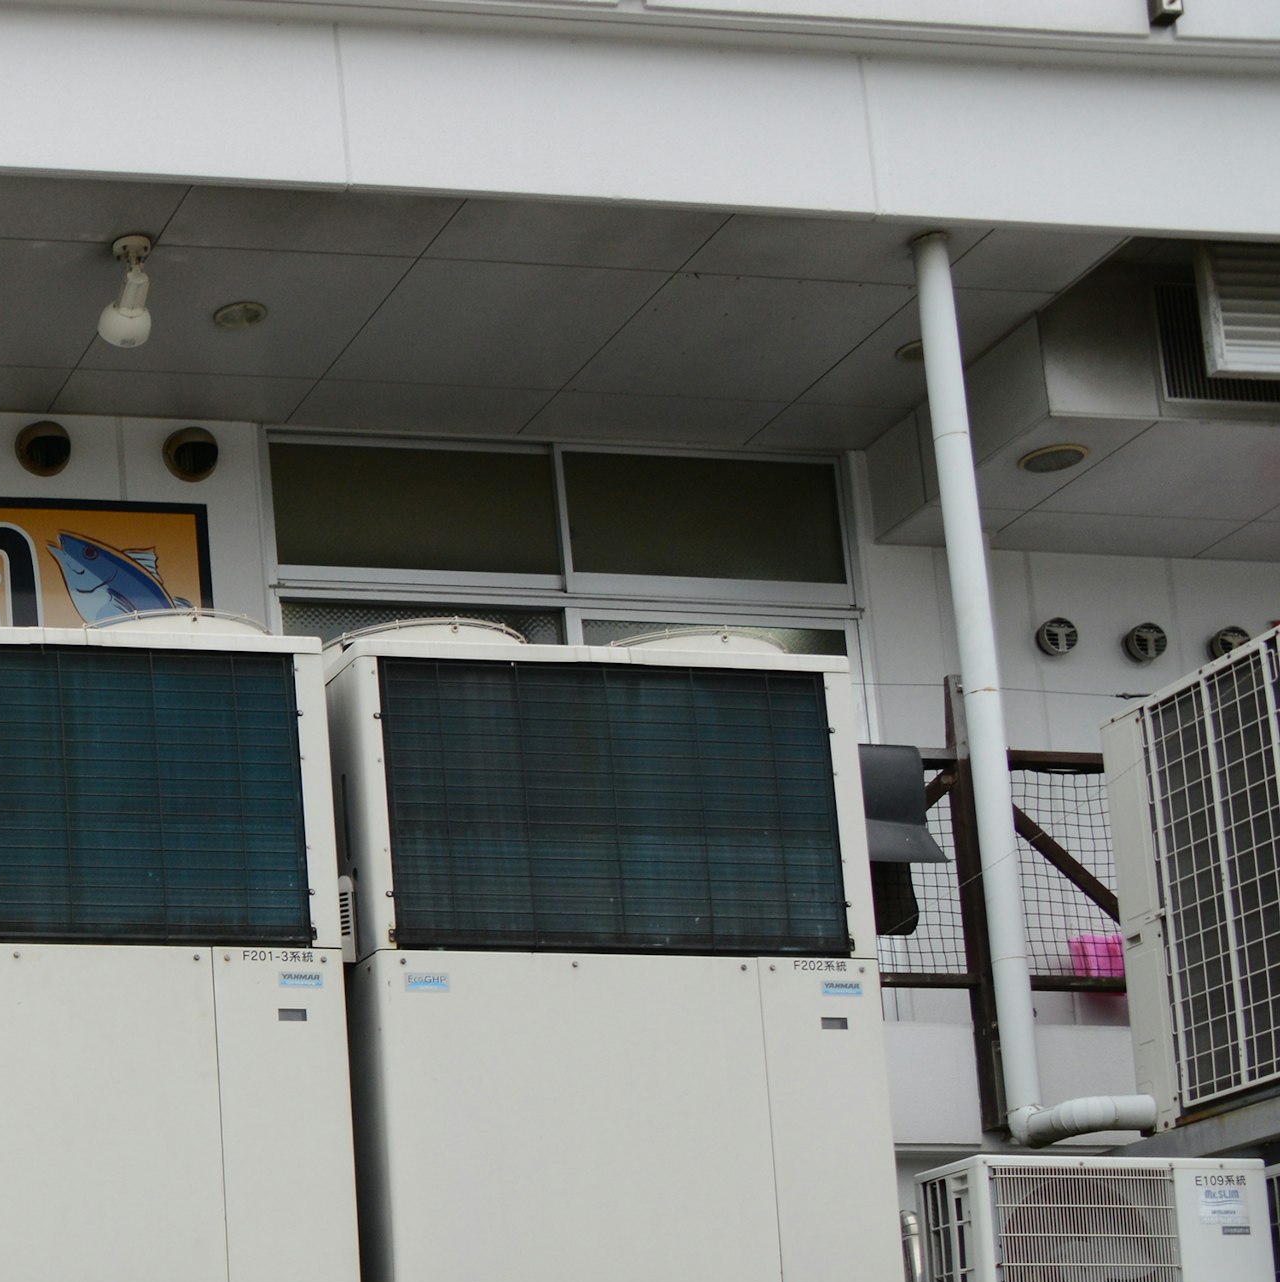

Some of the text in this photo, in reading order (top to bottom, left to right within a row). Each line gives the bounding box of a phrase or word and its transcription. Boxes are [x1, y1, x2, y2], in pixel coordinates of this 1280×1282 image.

[242, 950, 314, 963] F201-3系統
[794, 960, 847, 972] F202系統
[281, 973, 321, 981] YANMAR
[1195, 1175, 1246, 1186] E109系統
